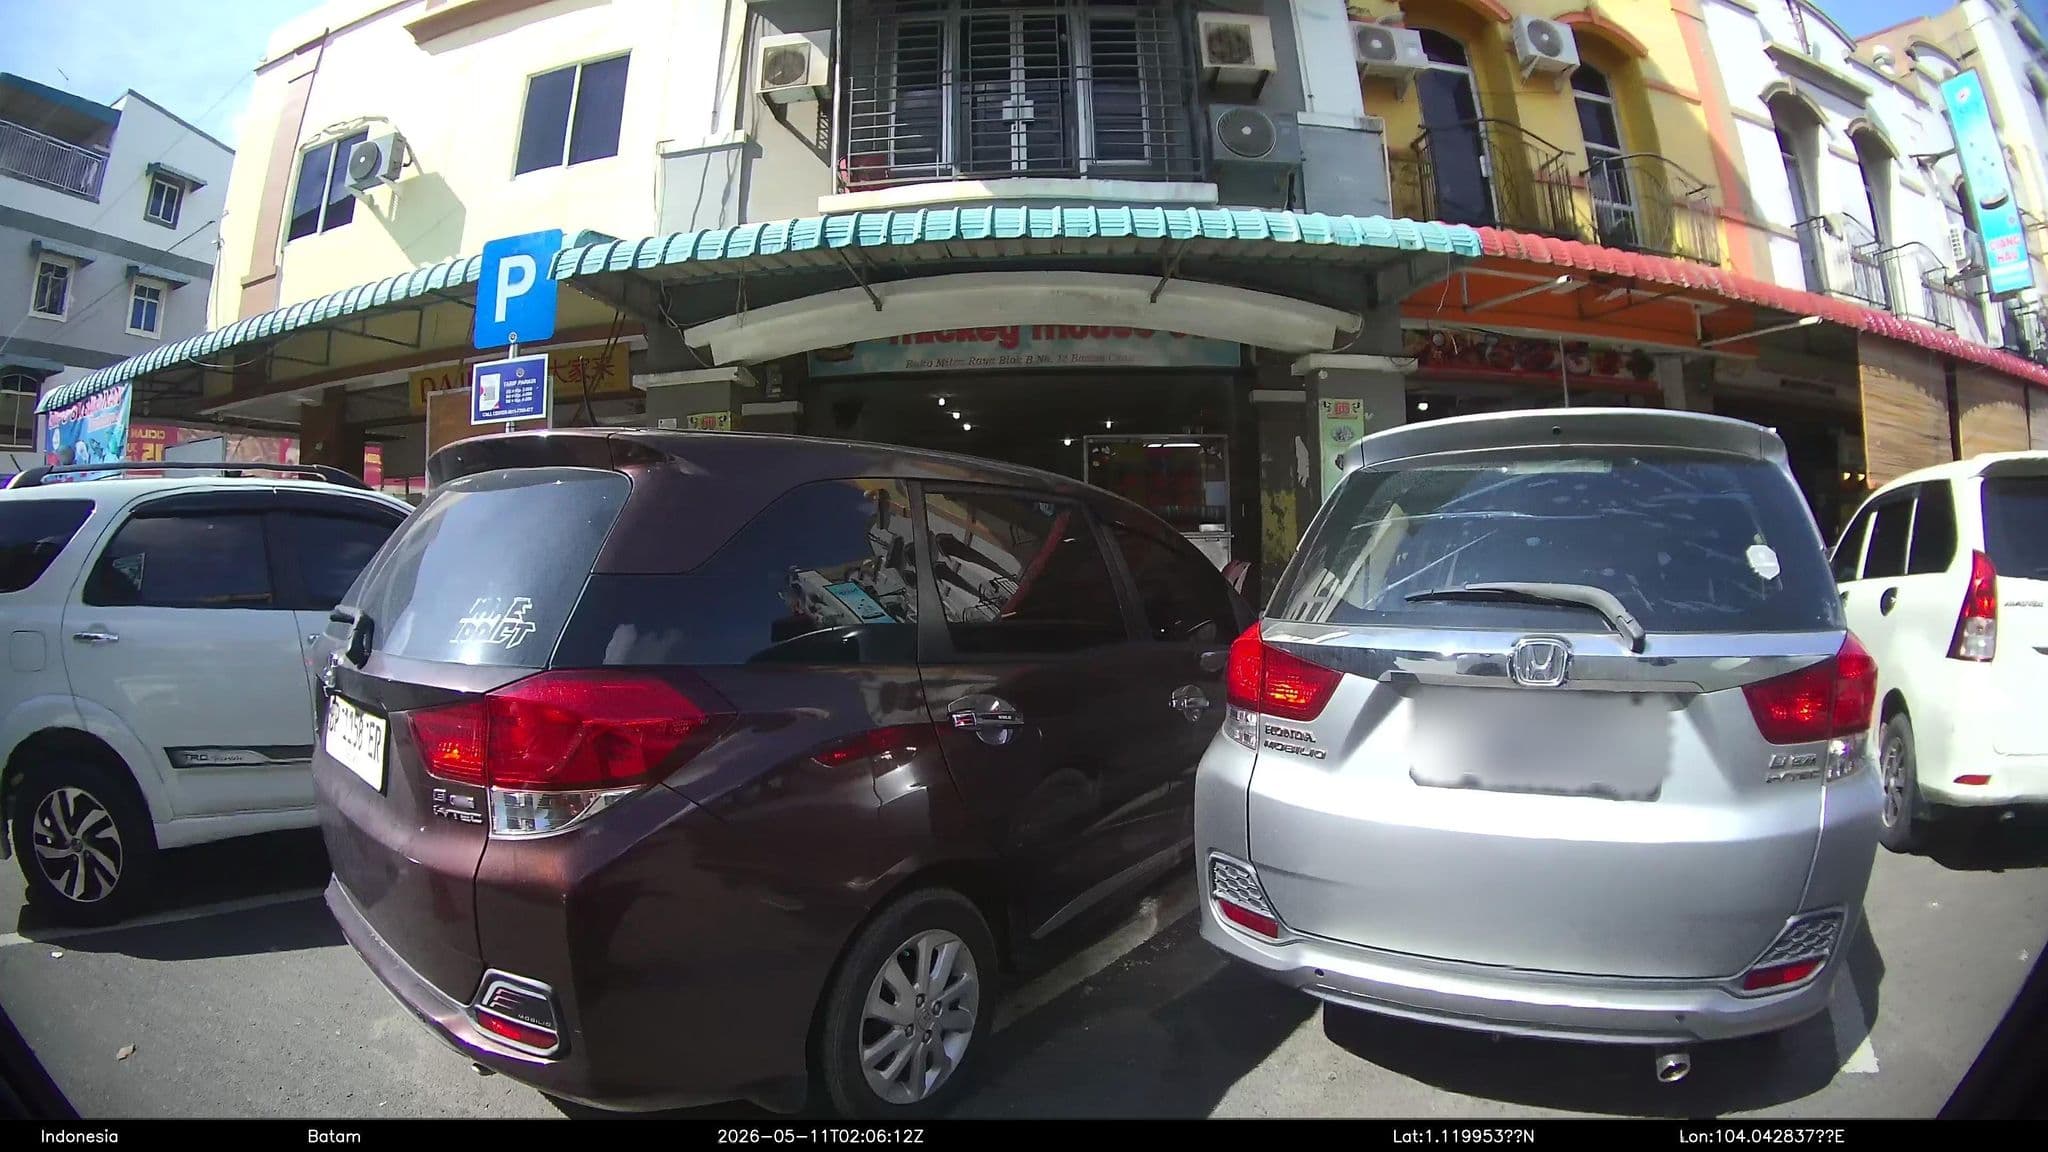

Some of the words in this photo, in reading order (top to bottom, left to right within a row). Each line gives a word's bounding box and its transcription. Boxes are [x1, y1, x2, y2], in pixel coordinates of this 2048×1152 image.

[495, 254, 537, 323] P
[366, 720, 382, 763] ER
[1264, 724, 1316, 743] HONDA
[184, 753, 209, 761] TRD
